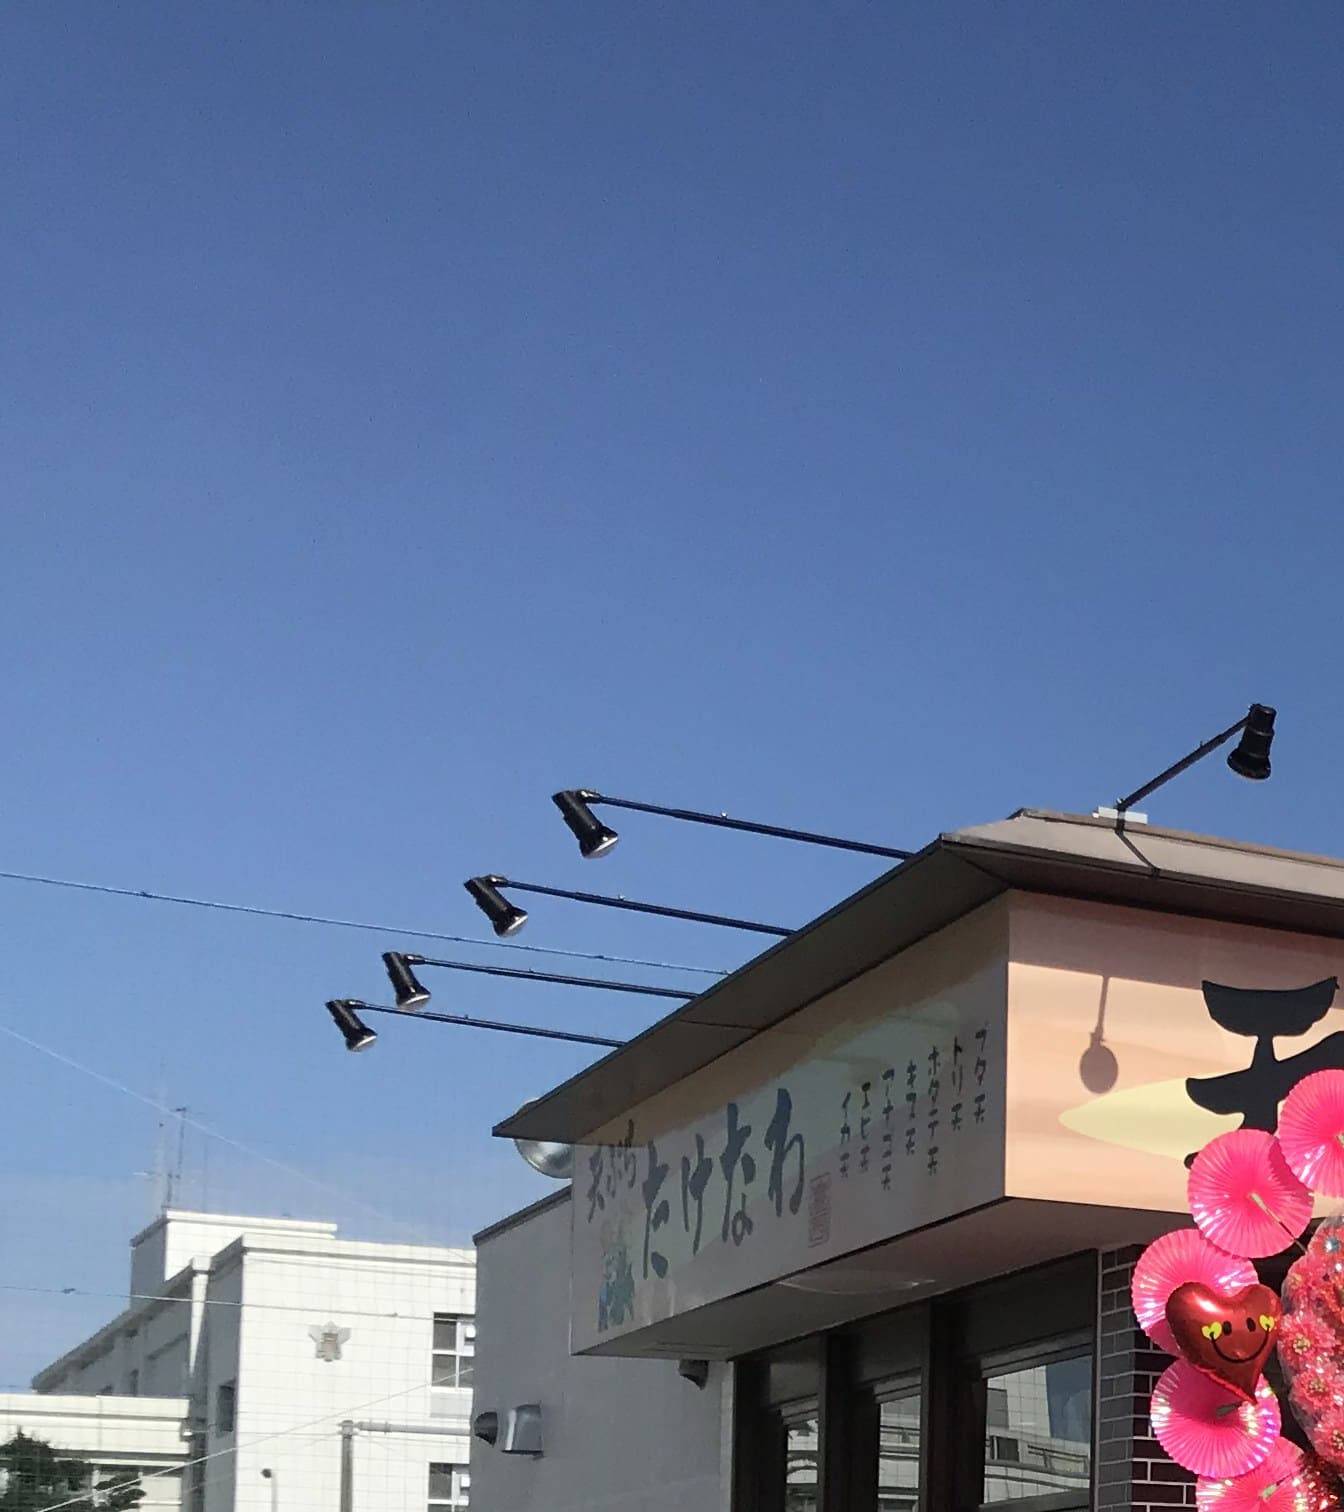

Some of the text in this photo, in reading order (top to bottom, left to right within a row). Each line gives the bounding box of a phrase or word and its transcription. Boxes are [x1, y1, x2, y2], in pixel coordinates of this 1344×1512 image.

[906, 1060, 918, 1157] キス天
[928, 1045, 940, 1177] ホタテ天
[951, 1037, 963, 1132] トリ天
[840, 1091, 851, 1179] イカ天
[642, 1088, 805, 1281] たけなわ
